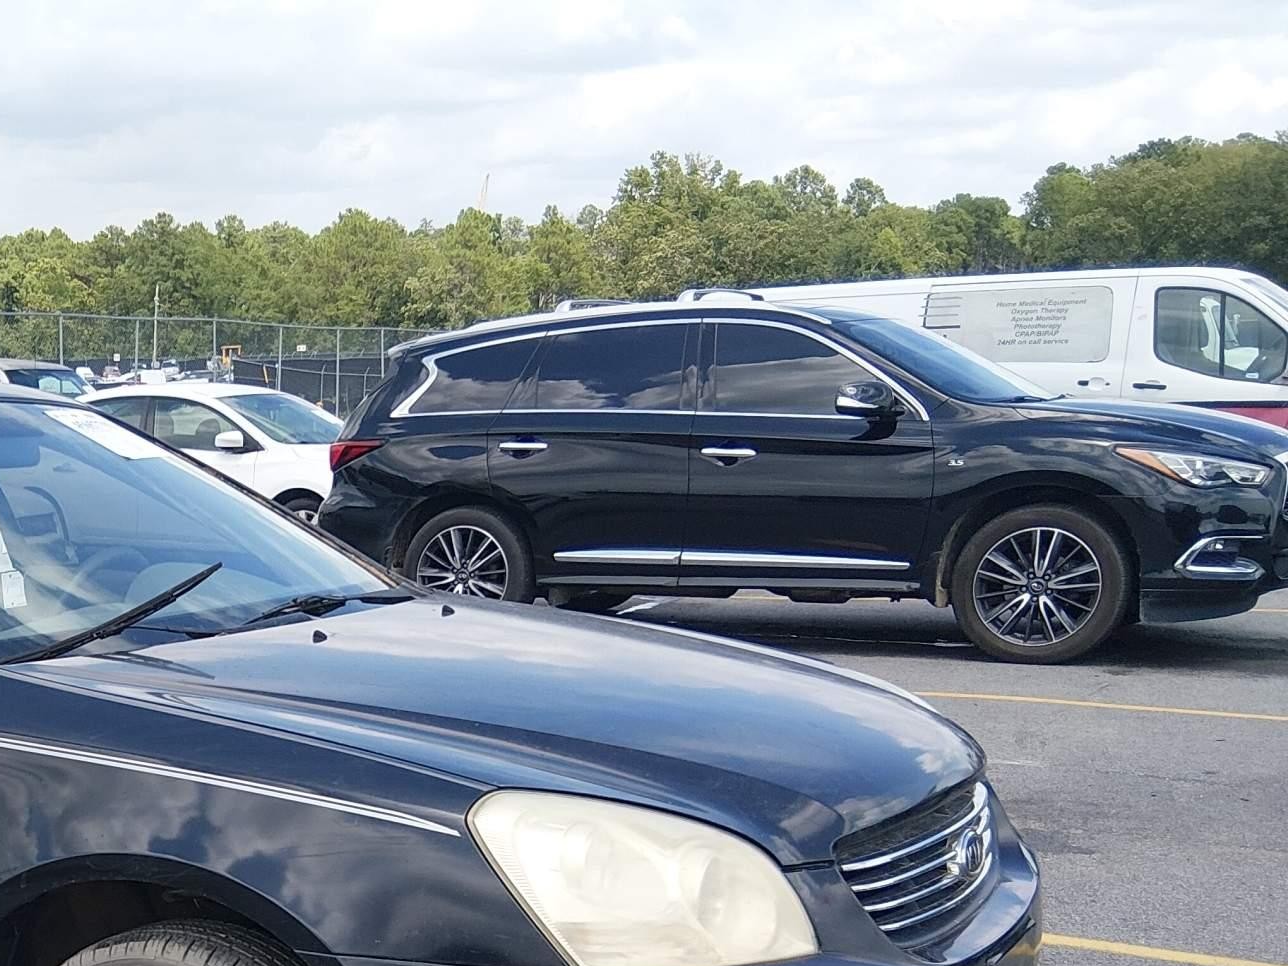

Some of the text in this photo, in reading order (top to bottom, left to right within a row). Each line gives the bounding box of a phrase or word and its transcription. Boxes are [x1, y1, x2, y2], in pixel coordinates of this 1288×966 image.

[1019, 299, 1046, 307] Medical
[1047, 298, 1087, 307] Equipment
[1011, 308, 1039, 316] Oxygen
